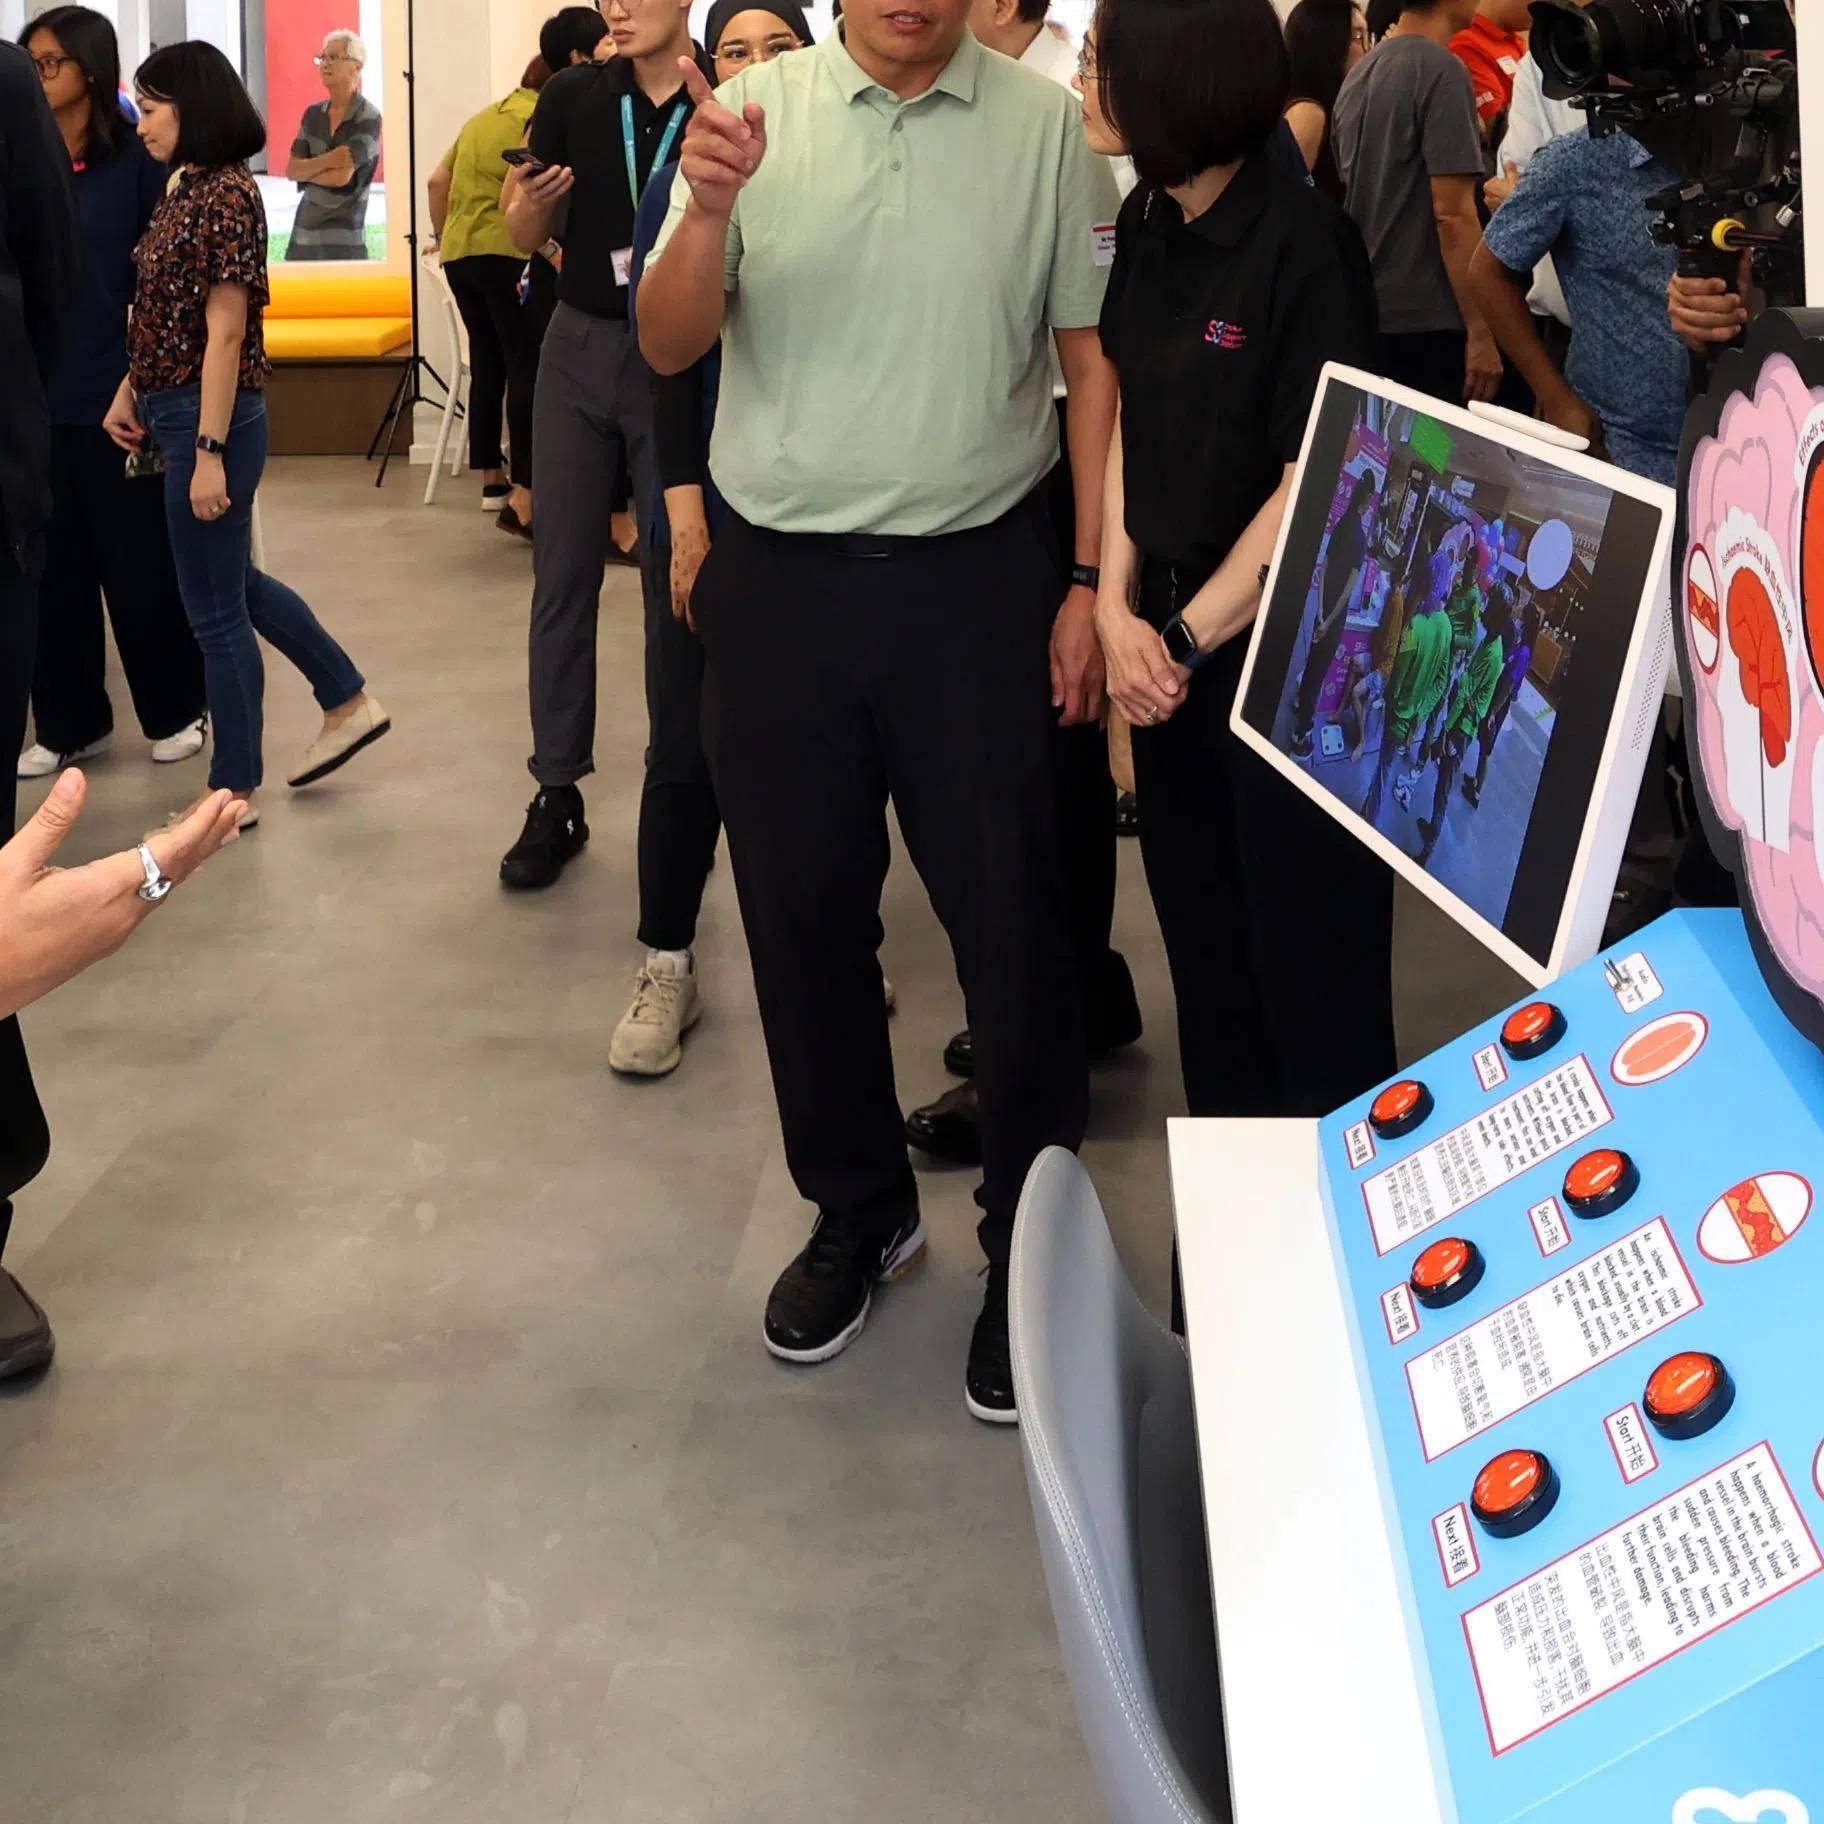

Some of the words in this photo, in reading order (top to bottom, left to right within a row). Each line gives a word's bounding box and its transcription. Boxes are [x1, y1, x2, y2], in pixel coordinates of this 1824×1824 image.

[1798, 422, 1819, 467] Effects
[1745, 537, 1763, 565] Stroke
[1538, 1206, 1552, 1228] Start
[1544, 1226, 1560, 1247] 开始
[1552, 1284, 1559, 1294] to
[1577, 1270, 1590, 1293] oxygen
[1588, 1298, 1600, 1311] and
[1617, 1248, 1632, 1267] vessel
[1626, 1268, 1634, 1278] in
[1631, 1280, 1640, 1293] the
[1637, 1294, 1649, 1314] brain
[1646, 1316, 1655, 1325] is
[1630, 1238, 1645, 1266] happens
[1642, 1268, 1654, 1287] when
[1655, 1296, 1670, 1317] blood
[1643, 1232, 1652, 1242] An
[1650, 1248, 1668, 1280] ischaemic
[1667, 1287, 1682, 1309] stroke
[1390, 1291, 1402, 1314] Next
[1565, 1278, 1577, 1296] which
[1572, 1298, 1584, 1320] causes
[1580, 1319, 1592, 1340] brain
[1587, 1341, 1600, 1357] cells
[1591, 1261, 1600, 1276] This
[1597, 1278, 1612, 1308] blockage
[1609, 1311, 1620, 1326] cuts
[1616, 1329, 1629, 1340] off
[1614, 1280, 1629, 1304] usually
[1622, 1302, 1632, 1314] by
[1629, 1318, 1641, 1334] clot.
[1616, 1415, 1635, 1444] Start
[1625, 1442, 1647, 1471] 开始
[1699, 1488, 1714, 1506] and
[1715, 1479, 1734, 1506] vessel
[1726, 1504, 1736, 1516] in
[1443, 1515, 1459, 1546] Next
[1706, 1506, 1724, 1536] causes
[1730, 1468, 1750, 1506] happens
[1748, 1511, 1764, 1536] when
[1761, 1540, 1770, 1548] a
[1766, 1550, 1787, 1579] blood
[1730, 1515, 1742, 1532] the
[1745, 1461, 1756, 1470] A
[1752, 1472, 1785, 1534] haemorrhagic
[1781, 1539, 1800, 1569] stroke
[1449, 1545, 1468, 1574] 接着
[1668, 1505, 1680, 1522] the
[1678, 1532, 1699, 1574] bleeding
[1700, 1584, 1716, 1617] harms
[1683, 1497, 1701, 1528] sudden
[1696, 1536, 1720, 1575] pressure
[1718, 1582, 1733, 1608] from
[1719, 1534, 1740, 1578] bleeding.
[1737, 1530, 1753, 1558] brain
[1622, 1532, 1638, 1564] further
[1633, 1567, 1652, 1606] damage.
[1637, 1523, 1652, 1545] their
[1645, 1545, 1664, 1588] function,
[1660, 1586, 1678, 1625] leading
[1674, 1623, 1684, 1636] to
[1652, 1513, 1667, 1539] brain
[1662, 1542, 1677, 1563] cells
[1671, 1565, 1687, 1584] and
[1680, 1587, 1700, 1627] disrupts
[1737, 1577, 1750, 1598] The
[1748, 1556, 1767, 1589] bursts
[1596, 1543, 1644, 1661] 出血性中风是指大脑中
[1545, 1572, 1591, 1695] 突发的出血会对脑细胞
